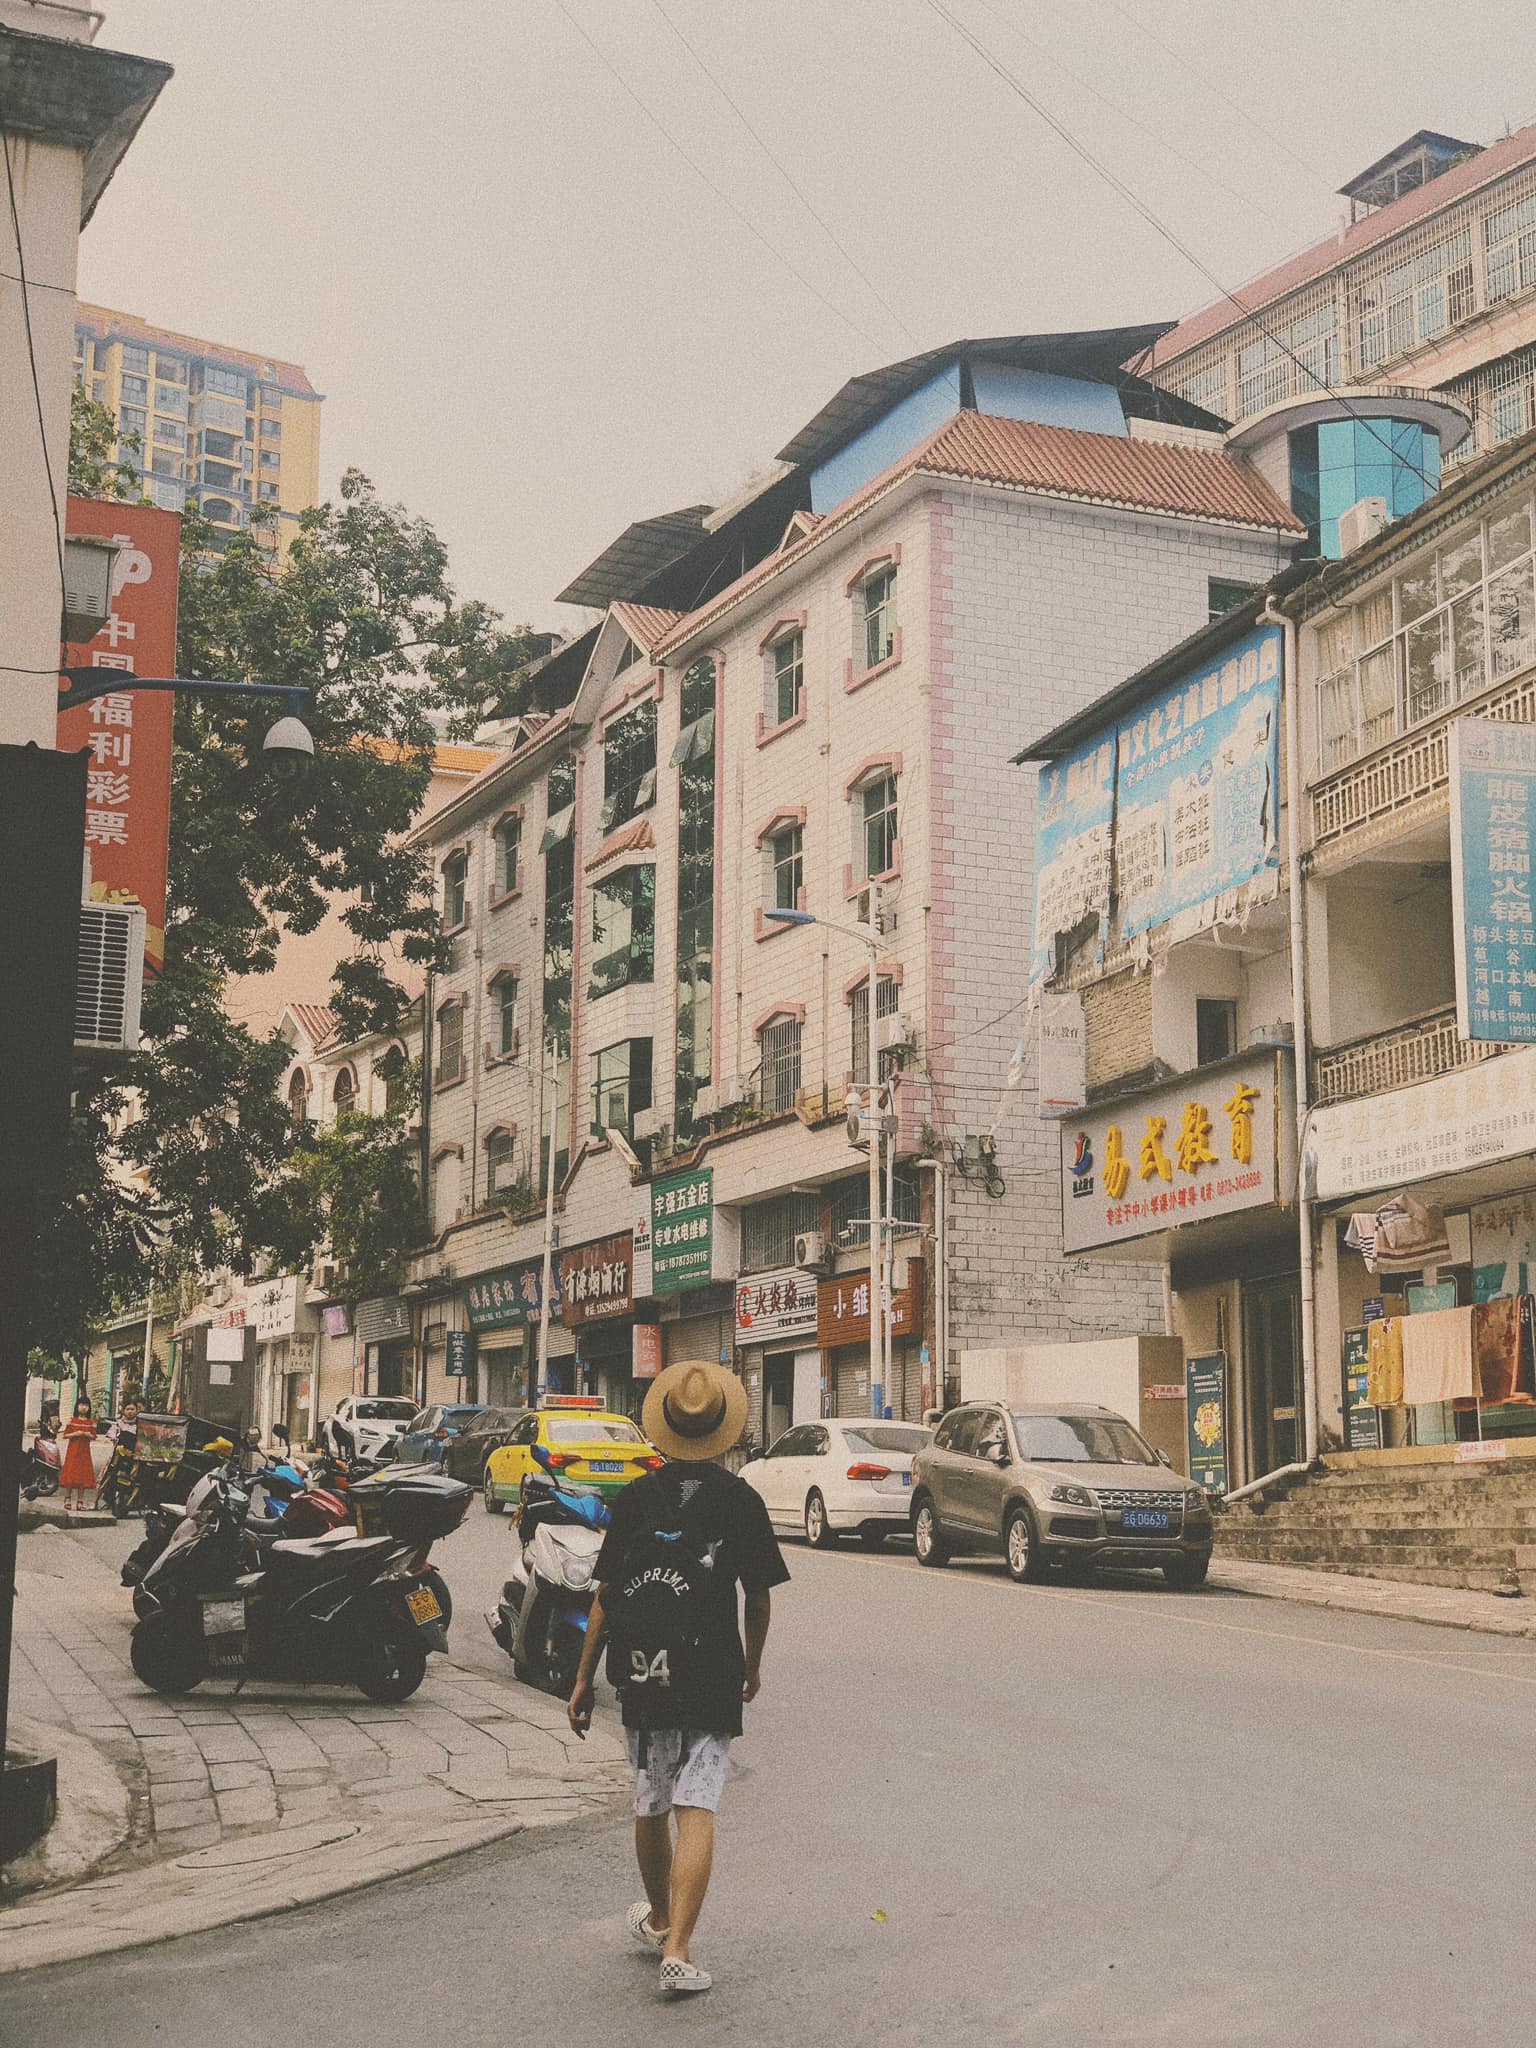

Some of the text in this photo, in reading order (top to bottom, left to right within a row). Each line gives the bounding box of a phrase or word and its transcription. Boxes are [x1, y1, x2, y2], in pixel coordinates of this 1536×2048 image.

[84, 612, 136, 846] 中国福利彩票
[655, 1218, 707, 1247] 专业水电维修
[624, 1567, 690, 1597] SUPREME
[630, 1650, 670, 1687] 94
